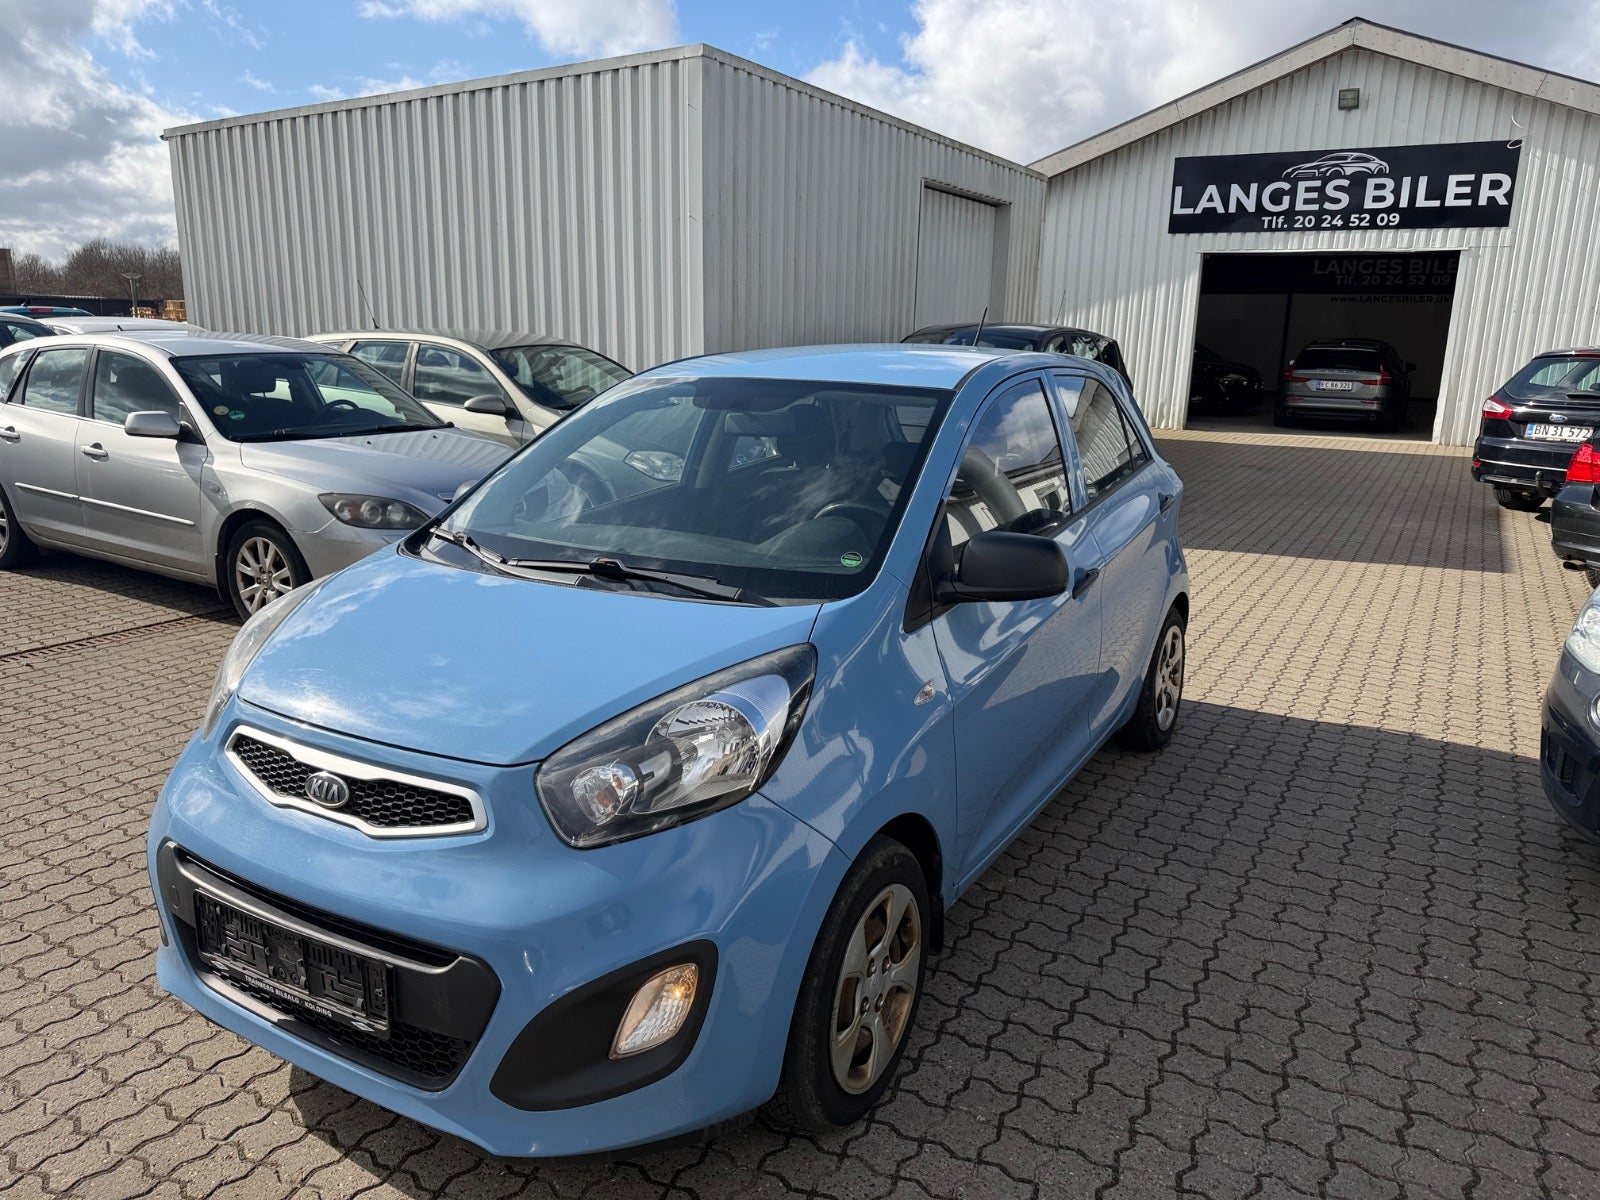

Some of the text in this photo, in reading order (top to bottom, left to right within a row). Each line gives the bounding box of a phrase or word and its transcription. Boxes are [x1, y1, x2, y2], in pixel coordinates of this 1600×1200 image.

[1172, 172, 1513, 215] LANGES BILER
[1261, 212, 1400, 229] Tlf. 20 24 52 09
[1313, 258, 1403, 274] LANGES
[1335, 274, 1451, 286] Tlf. 20 24 52 09
[1534, 424, 1591, 438] BN 31 572
[310, 778, 339, 802] KIA
[275, 987, 300, 1004] BILSALG
[304, 1001, 332, 1018] KOLDING
